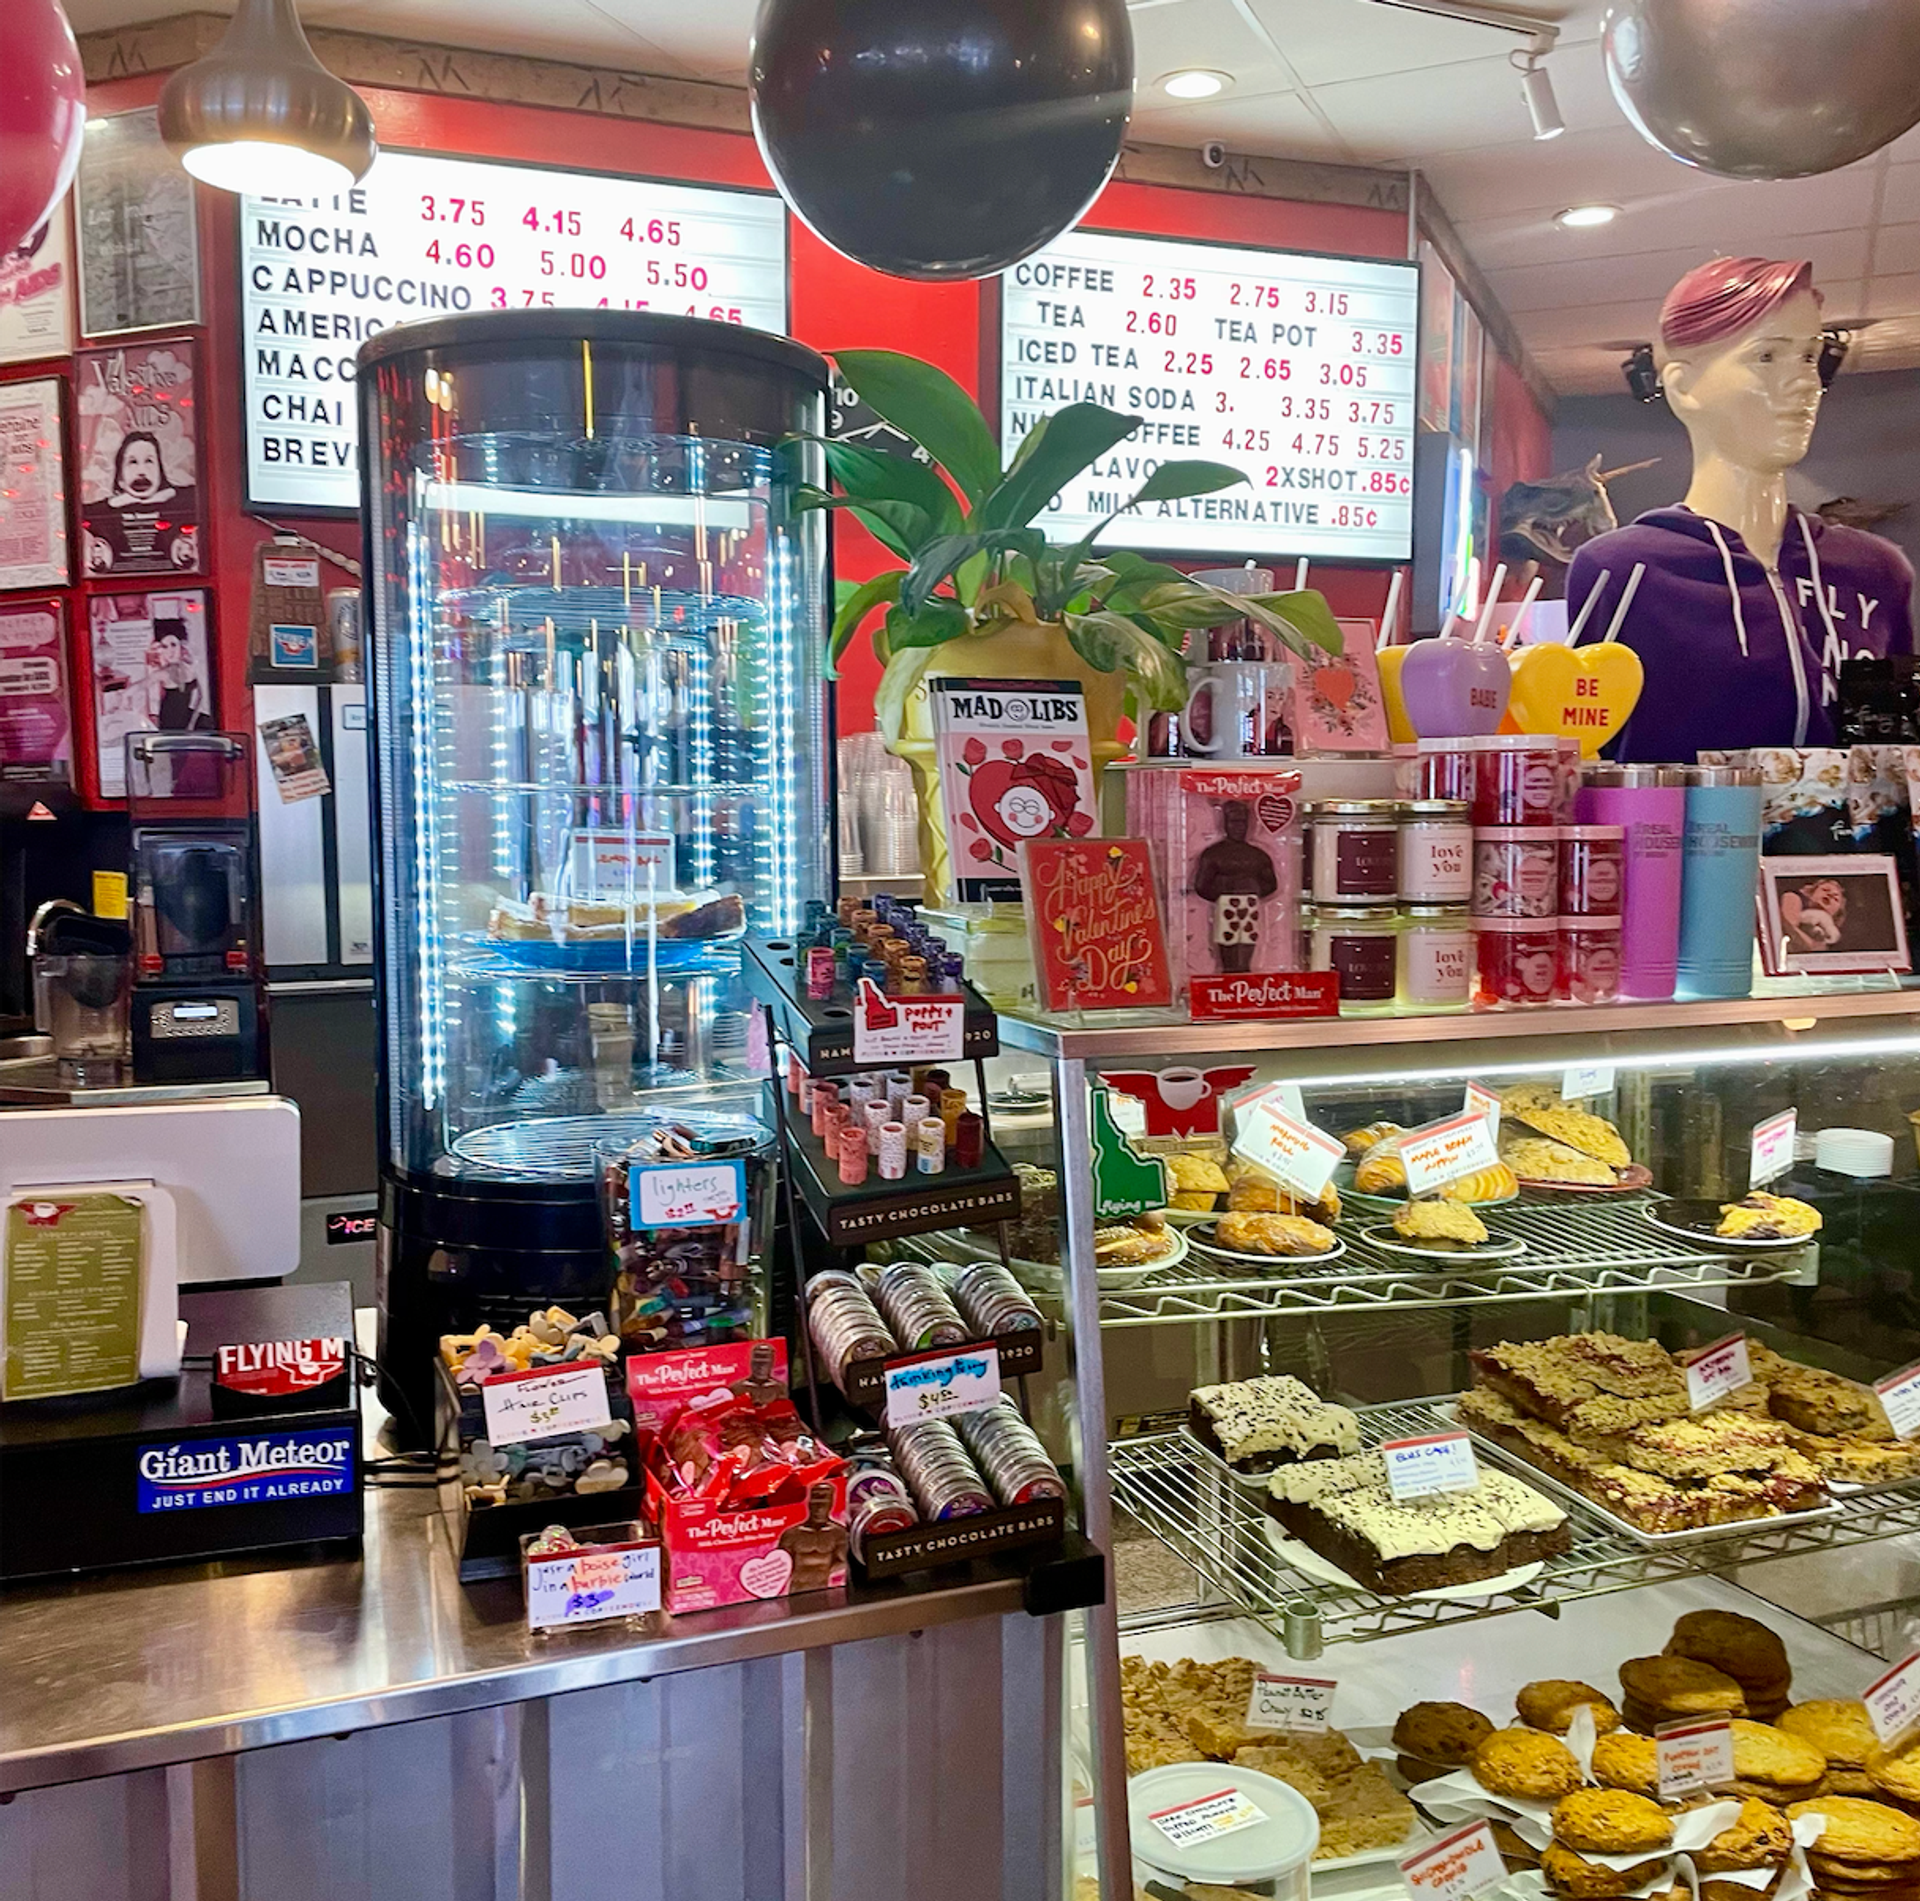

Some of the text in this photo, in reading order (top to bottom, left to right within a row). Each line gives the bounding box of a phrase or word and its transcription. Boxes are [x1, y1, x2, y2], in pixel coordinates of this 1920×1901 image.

[421, 195, 681, 247] 3.75 4.15 4.65
[257, 219, 708, 292] MOCHA 4.60 5.00 5.50
[1015, 262, 1349, 316] COFFEE 2.35 2.75 3.15
[257, 308, 398, 342] AMERIC
[1037, 301, 1403, 356] TEA 2.60 TEA POT 3.35
[257, 349, 358, 383] MACC
[1017, 338, 1368, 388] ICED TEA 2.25 2.65 3.05
[262, 394, 343, 426] CHAI
[834, 387, 860, 407] 10
[1016, 376, 1395, 426] ITALIAN SODA 3. 3.35 3.75
[263, 436, 352, 467] BREV
[1222, 427, 1270, 452] 4.25
[1291, 432, 1340, 457] 4.75
[1357, 438, 1406, 461] 5.25
[1092, 457, 1160, 480] LAVO
[1157, 497, 1319, 525] ALTERNATIVE
[1575, 678, 1599, 697] BE
[950, 695, 1079, 722] MAD LIBS
[1562, 707, 1610, 727] MINE
[1211, 776, 1263, 798] Perfect
[1431, 844, 1463, 859] love
[1037, 852, 1142, 908] Happy
[1431, 859, 1462, 877] you
[1046, 896, 1156, 958] Valentine's
[1057, 938, 1152, 992] Day
[1435, 950, 1466, 964] love
[1436, 964, 1463, 981] you
[1207, 976, 1322, 1007] The Perfect Man
[652, 1176, 718, 1207] lighters
[840, 1192, 1014, 1230] TASTY CHOCOLATE BARS
[219, 1338, 345, 1375] FLYING M
[636, 1372, 659, 1386] The
[654, 1359, 710, 1385] Perfect
[238, 1438, 350, 1466] Meteor
[152, 1478, 344, 1510] JUST END IT ALREADY
[686, 1525, 709, 1539] The
[704, 1513, 760, 1539] Perfect
[876, 1515, 1055, 1562] TASTY CHOCOLATE BARS
